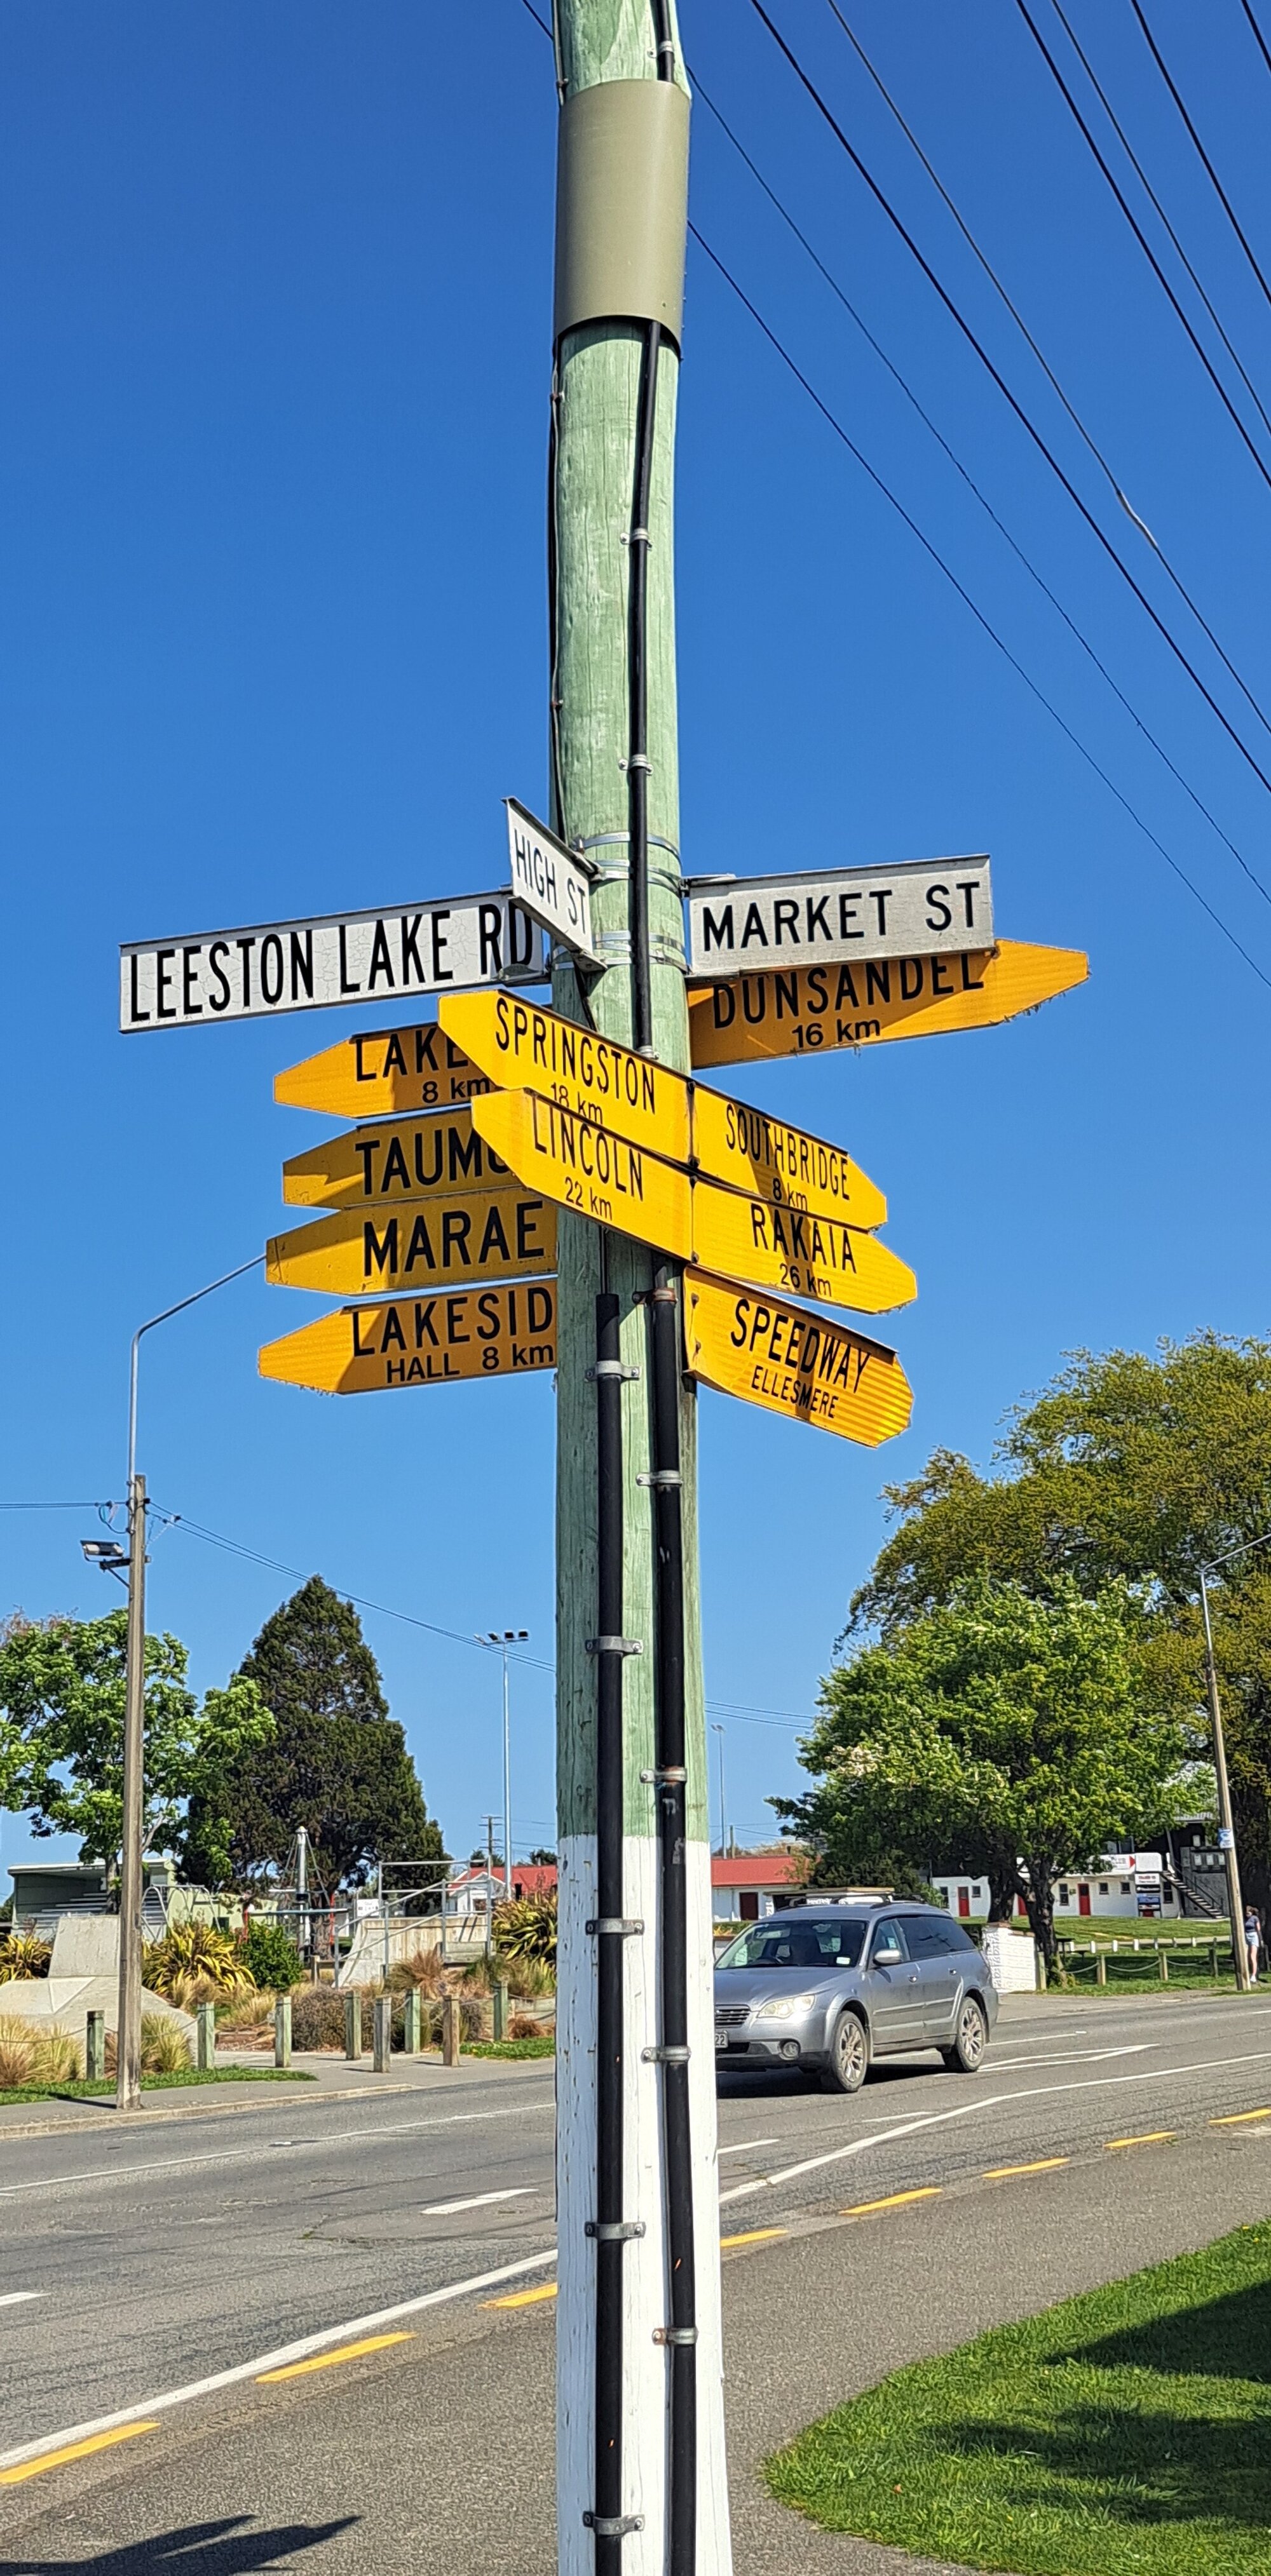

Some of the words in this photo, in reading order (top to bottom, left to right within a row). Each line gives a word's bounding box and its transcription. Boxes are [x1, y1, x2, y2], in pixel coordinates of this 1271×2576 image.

[514, 828, 557, 910] HIGH
[568, 877, 585, 934] ST
[703, 889, 892, 952] MARKET
[925, 881, 980, 931] ST
[131, 929, 314, 1022] LEESTON
[338, 910, 453, 994] LAKE
[479, 900, 533, 974] RD
[713, 953, 984, 1029] DUNSANDEL
[496, 997, 655, 1114] SPRINGSTON
[792, 1022, 823, 1048] 16
[838, 1018, 880, 1042] km
[423, 1081, 438, 1103] 8
[451, 1077, 489, 1099] km
[550, 1082, 569, 1107] 18
[578, 1092, 603, 1124] km
[533, 1097, 642, 1201] LINCOLN
[726, 1104, 850, 1200] SOUTHBRIDGE
[564, 1177, 583, 1208] 22
[590, 1186, 612, 1220] km
[773, 1178, 782, 1201] 8
[787, 1182, 808, 1211] km
[364, 1201, 545, 1276] MARAE
[751, 1204, 857, 1273] RAKAIA
[780, 1264, 799, 1288] 26
[807, 1268, 832, 1297] km
[387, 1353, 459, 1383] HALL
[482, 1347, 500, 1370] 8
[513, 1343, 554, 1365] km
[730, 1298, 871, 1393] SPEEDWAY
[752, 1365, 838, 1419] ELLESMERE
